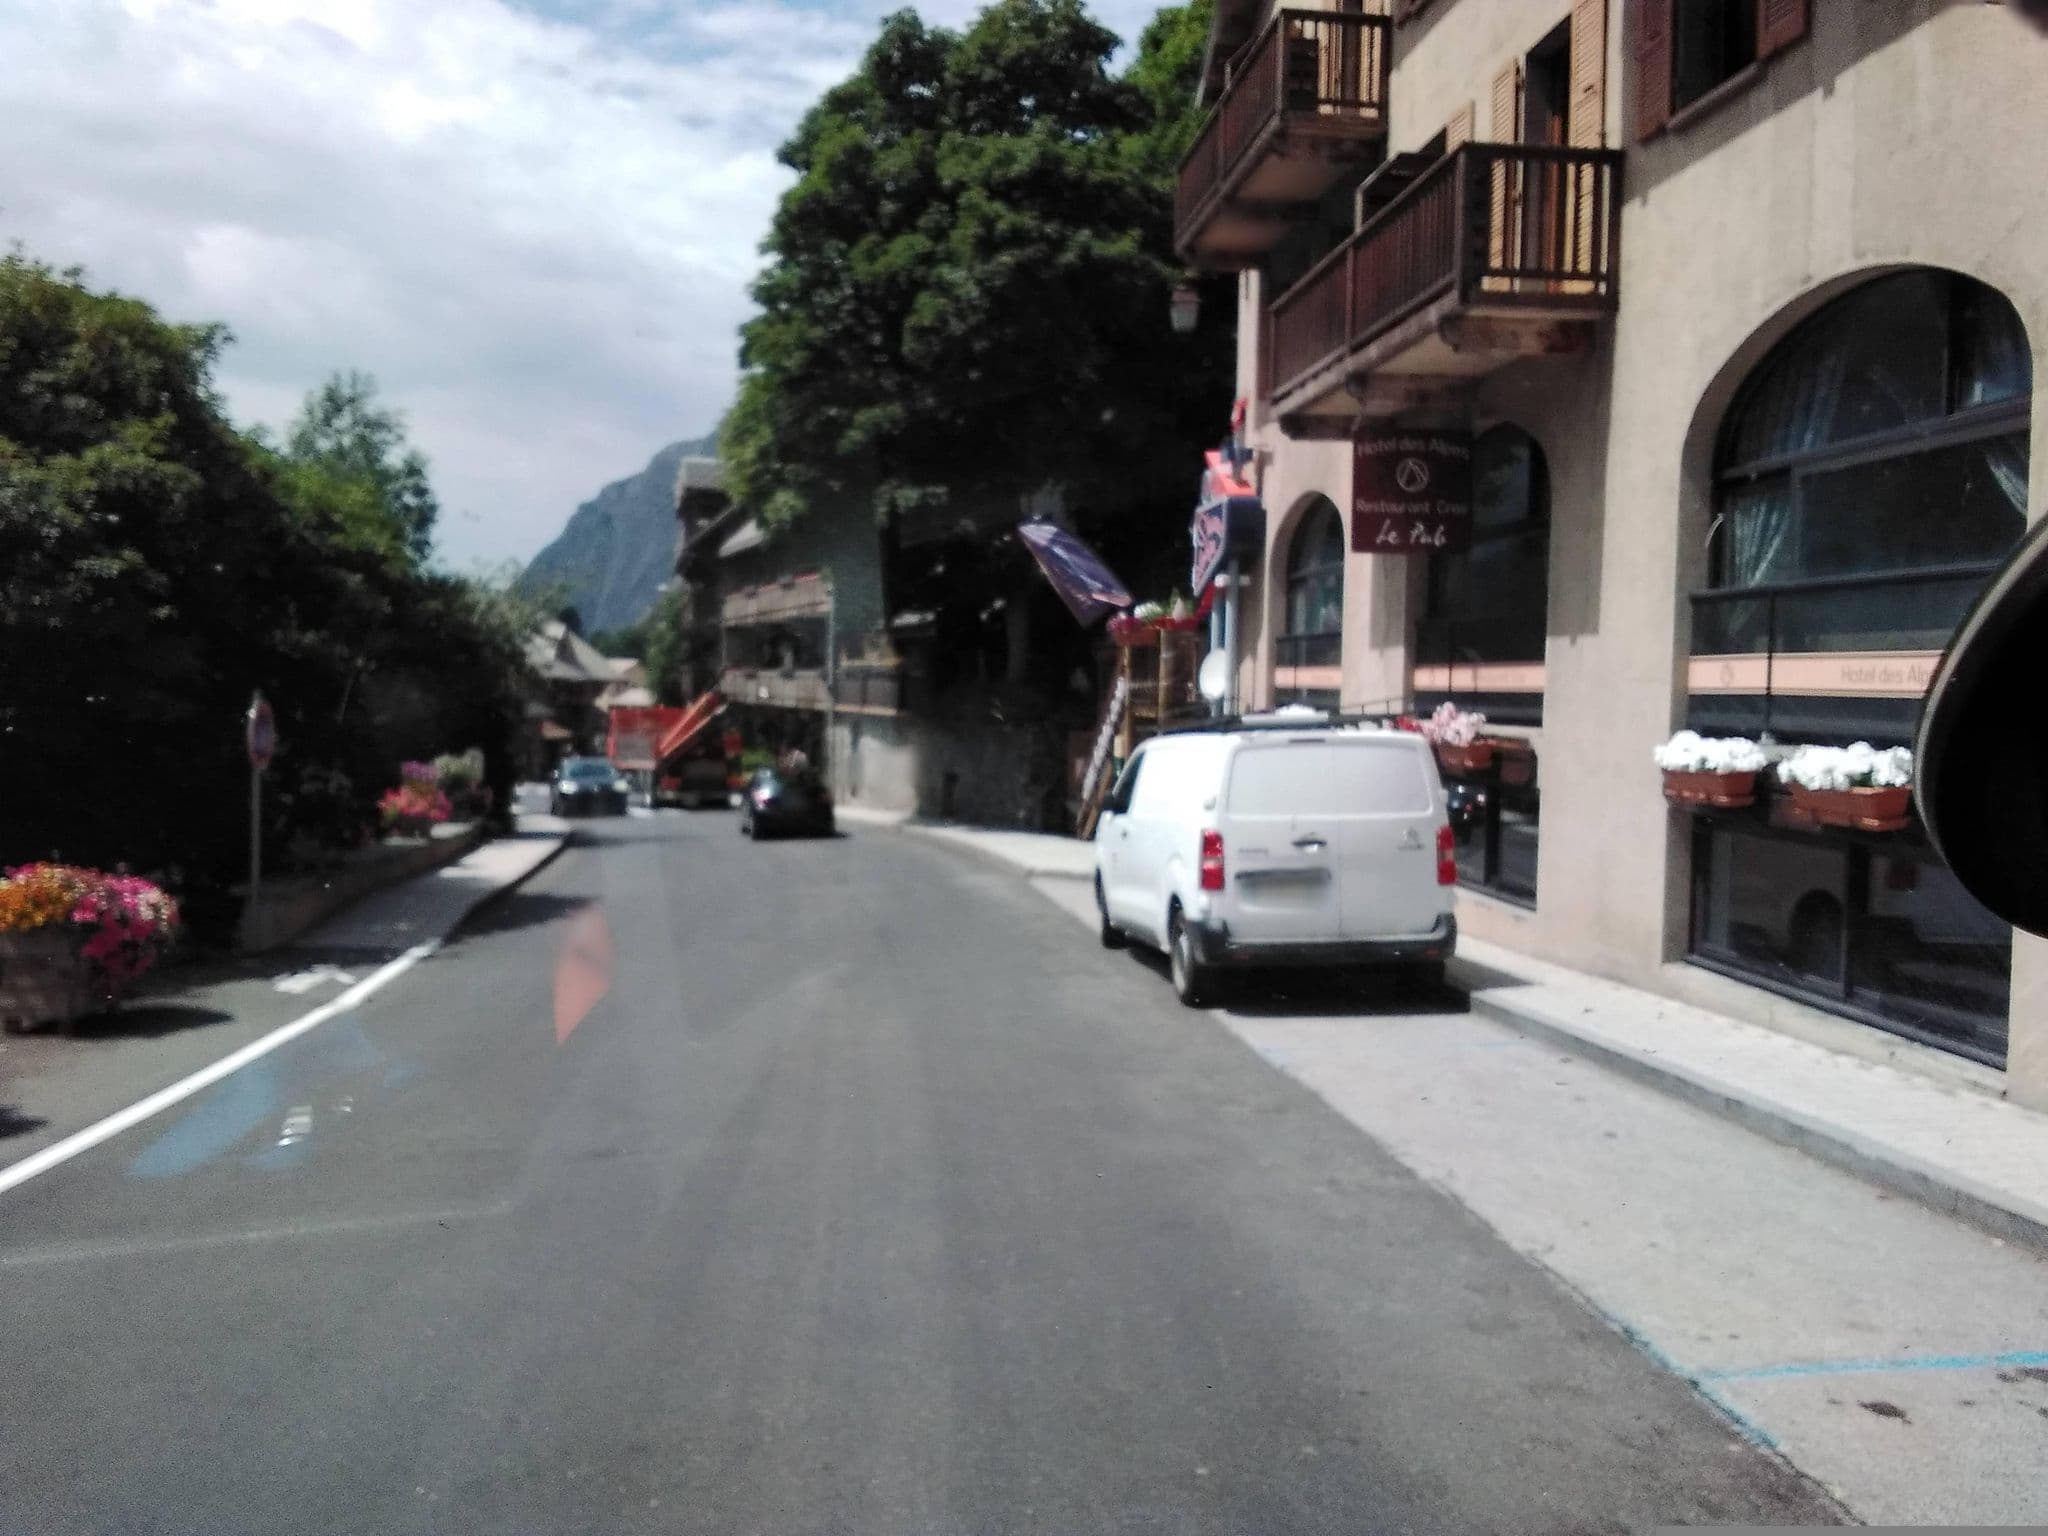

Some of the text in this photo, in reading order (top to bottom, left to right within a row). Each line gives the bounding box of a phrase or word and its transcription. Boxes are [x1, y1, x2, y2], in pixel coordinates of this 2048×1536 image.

[1375, 517, 1401, 546] Le
[1840, 664, 1876, 683] Hotel
[1879, 664, 1904, 684] des
